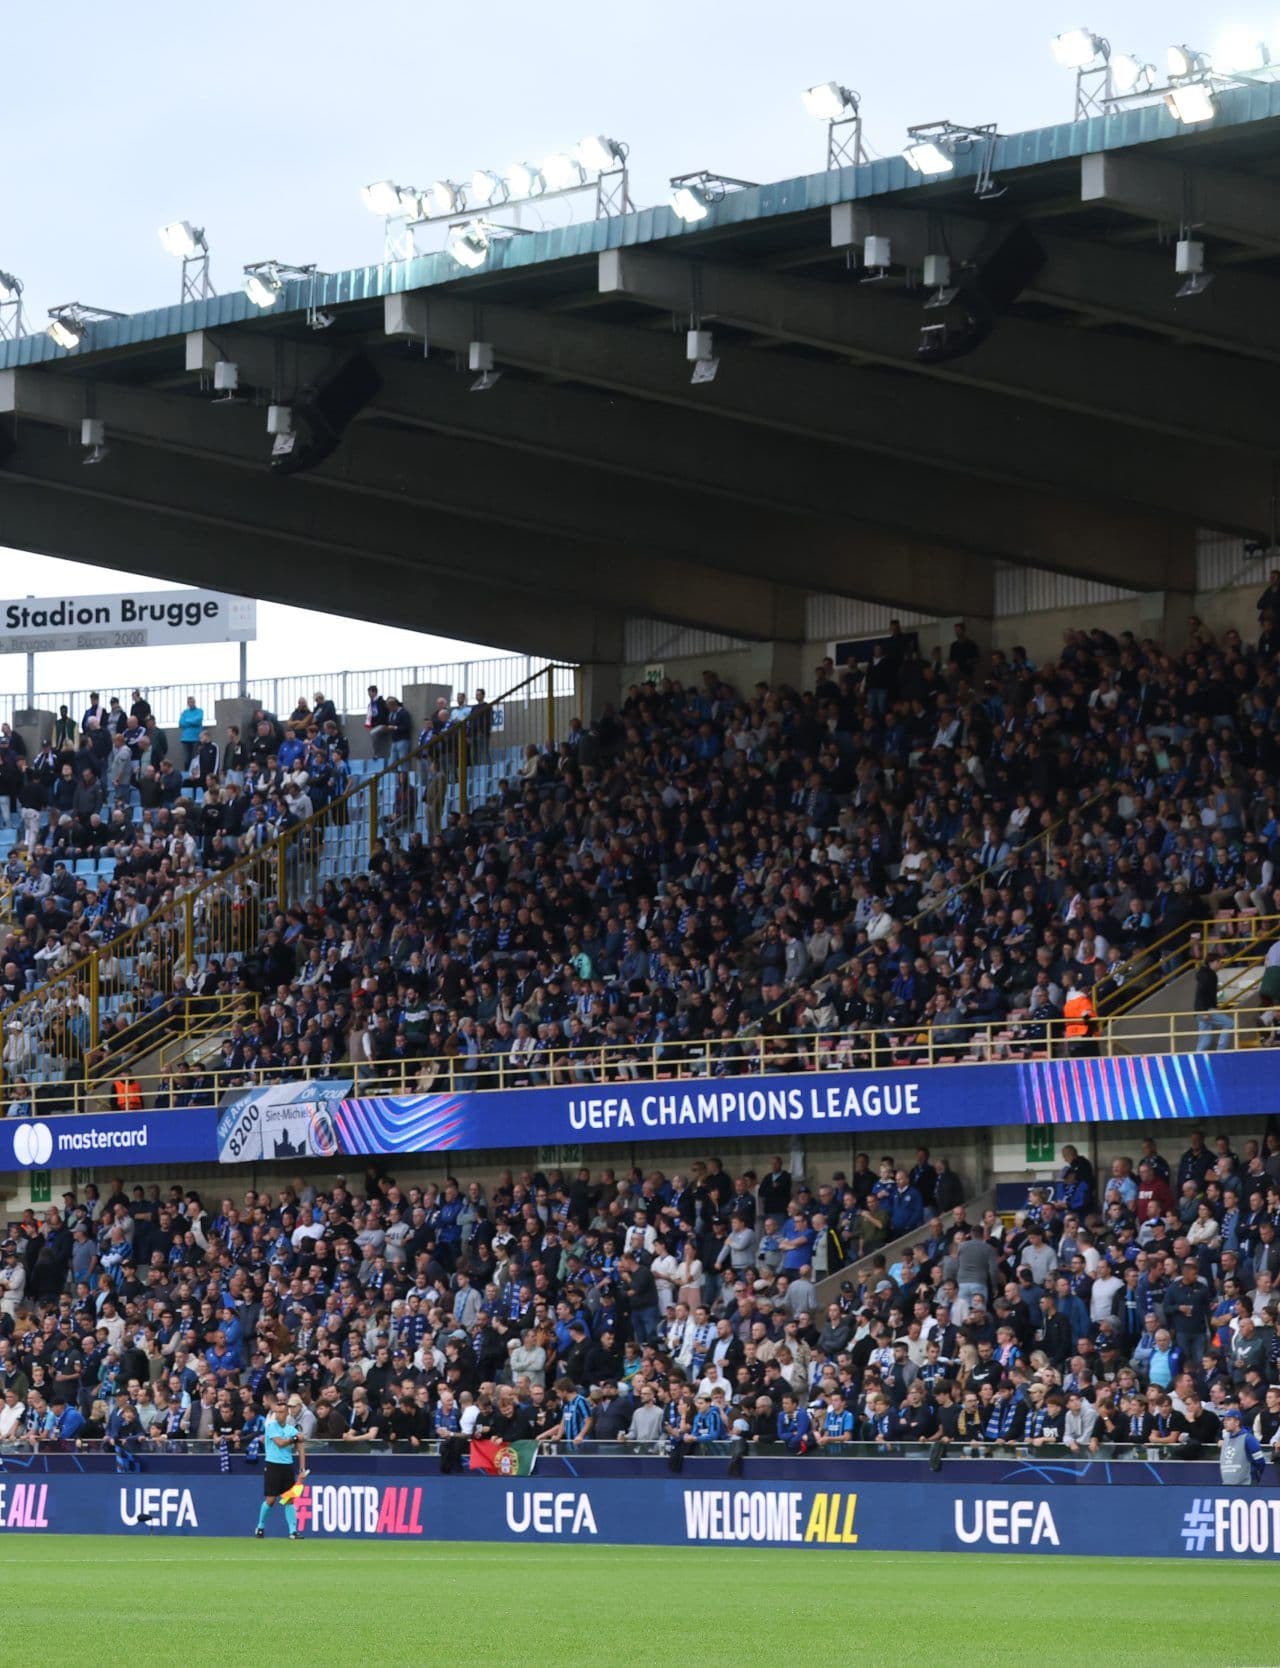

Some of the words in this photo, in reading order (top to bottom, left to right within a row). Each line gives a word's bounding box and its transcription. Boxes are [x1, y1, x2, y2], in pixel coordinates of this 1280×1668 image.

[6, 600, 111, 630] Stadion
[120, 598, 220, 627] Brugge
[114, 631, 145, 646] 2000
[569, 1098, 635, 1130] UEFA
[641, 1089, 804, 1127] CHAMPIONS
[811, 1084, 921, 1119] LEAGUE
[58, 1125, 148, 1151] mastercard
[229, 1104, 260, 1157] 8200
[7, 1483, 49, 1528] ALL
[120, 1487, 199, 1528] UEFA
[293, 1485, 424, 1534] #FOOTBALL
[506, 1491, 598, 1534] UEFA
[683, 1490, 803, 1541] WELCOME
[804, 1493, 858, 1544] ALL
[954, 1499, 1061, 1546] UEFA
